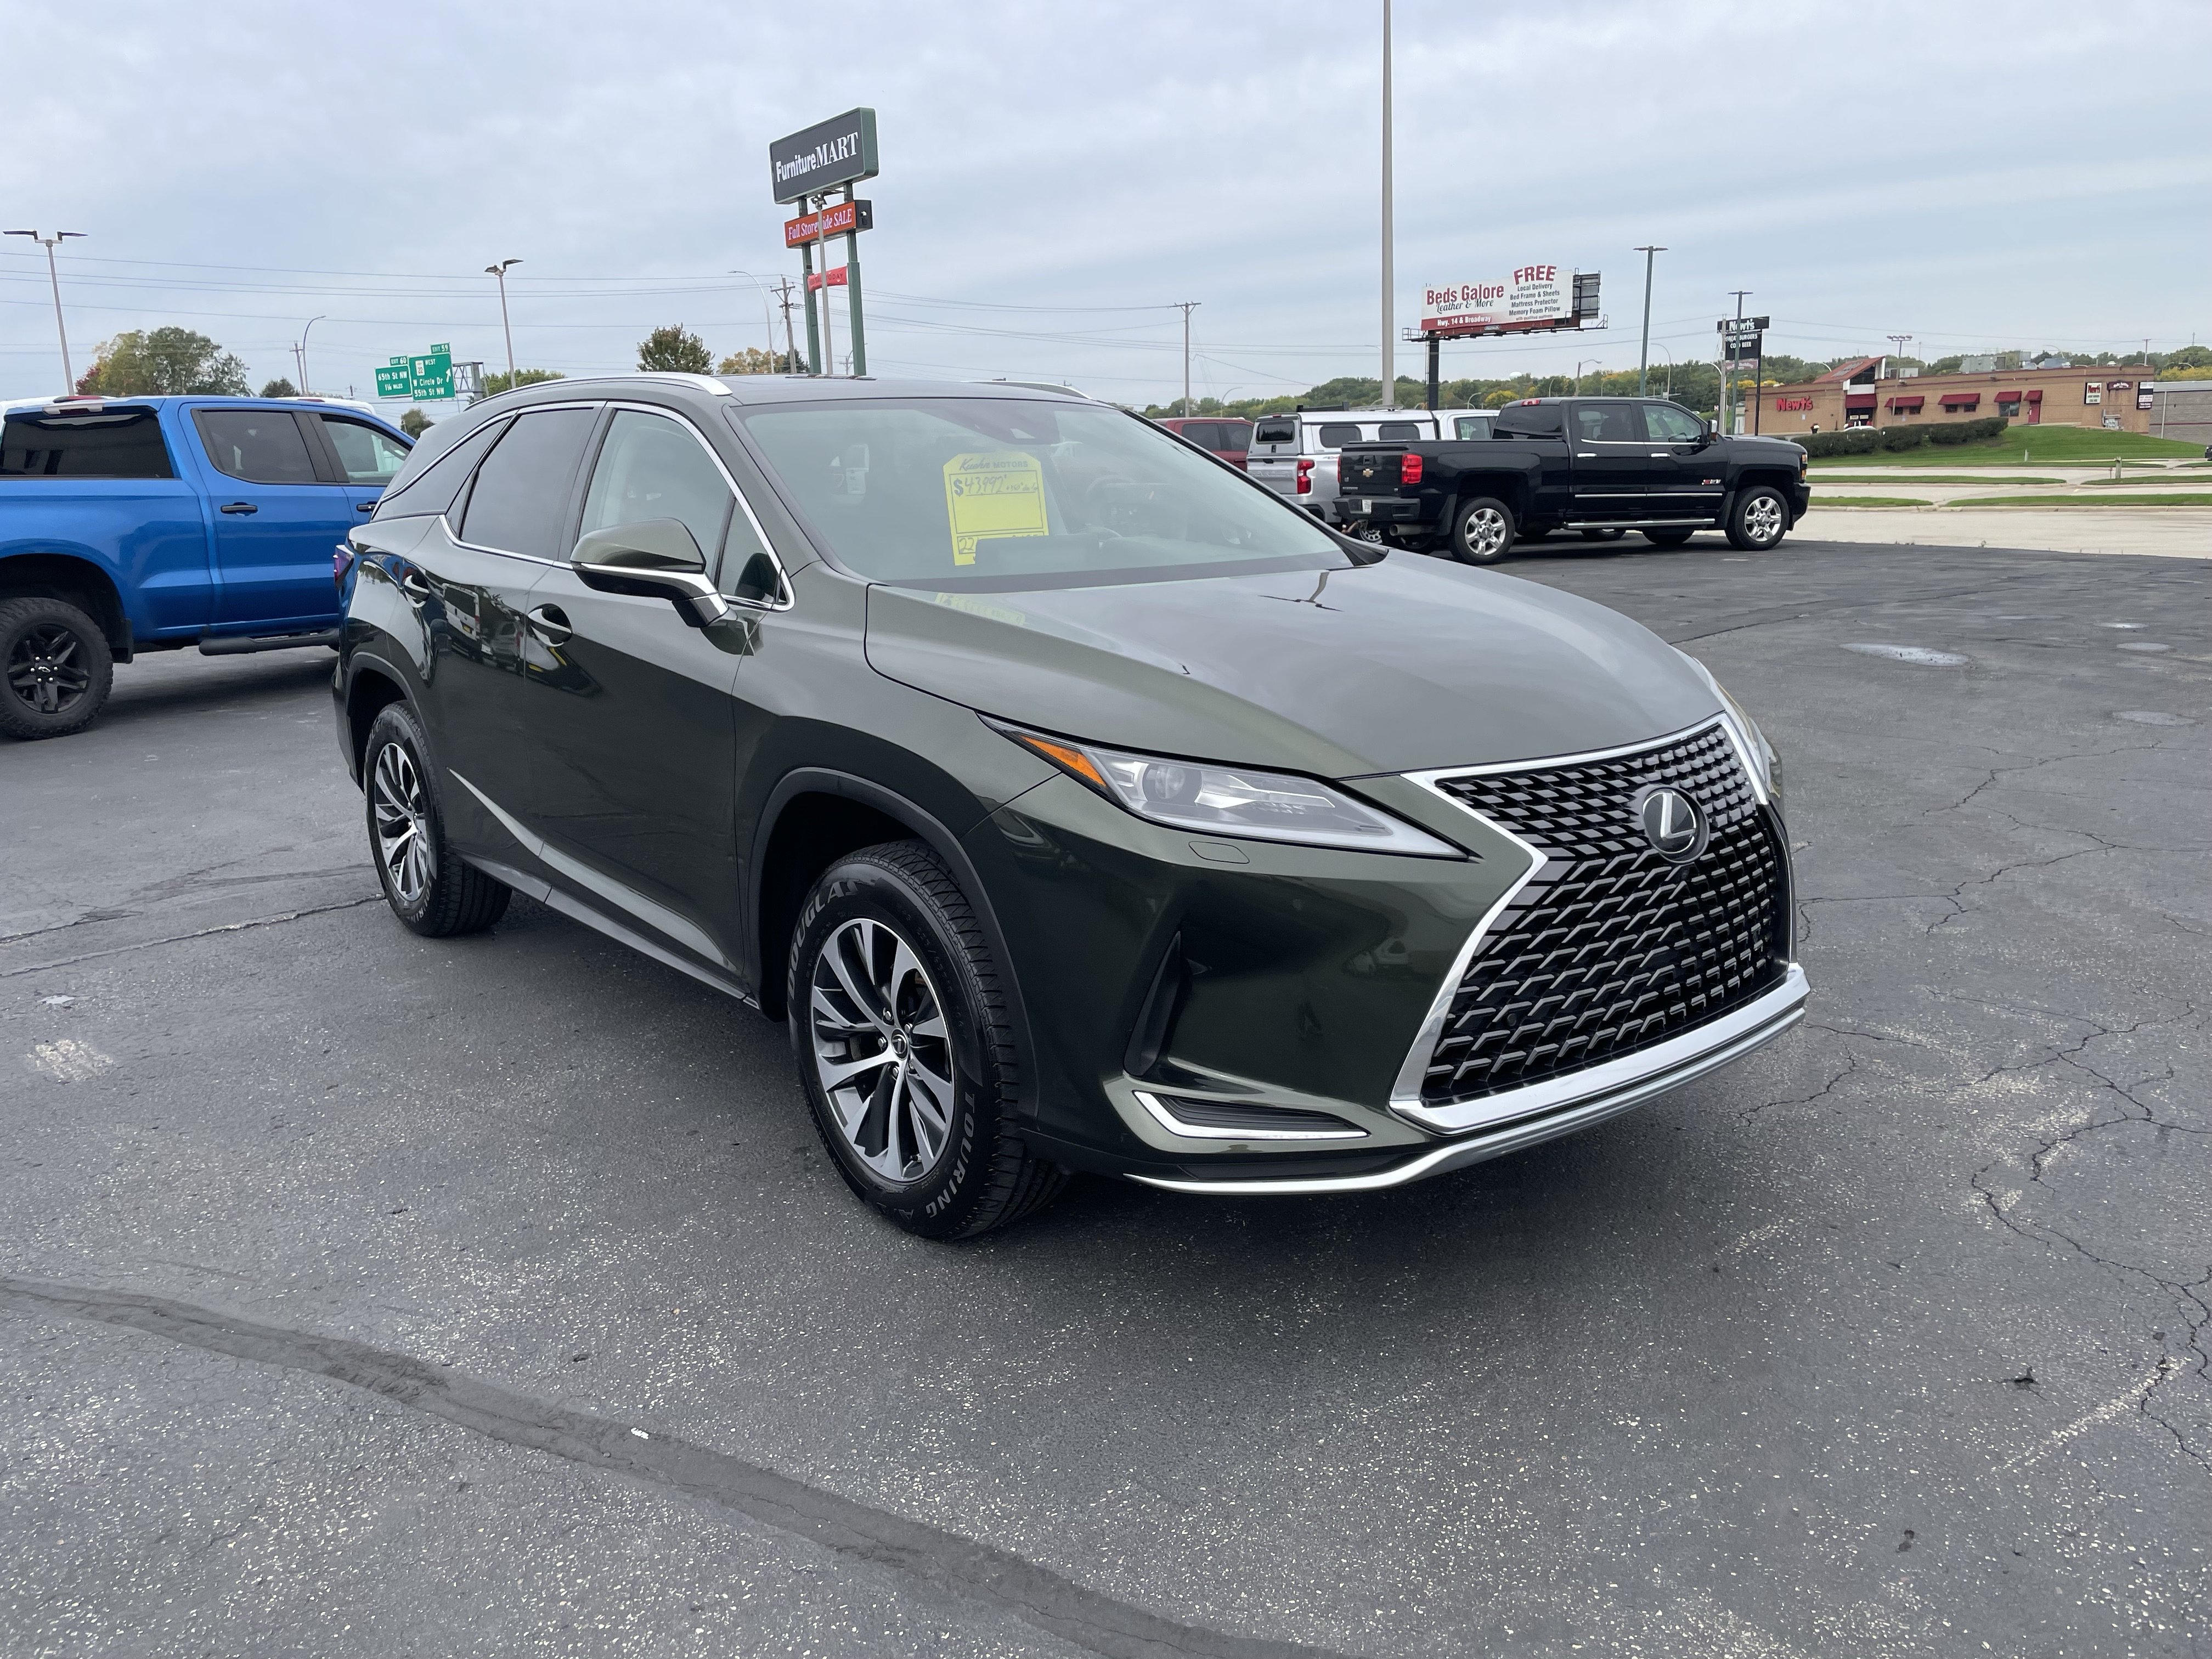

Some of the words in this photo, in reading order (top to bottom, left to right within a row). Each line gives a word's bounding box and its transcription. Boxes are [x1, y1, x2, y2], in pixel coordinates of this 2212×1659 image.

[776, 132, 859, 182] FurnitureMART
[788, 224, 799, 240] Fall
[801, 215, 833, 236] Storeide
[834, 208, 852, 227] SALE
[1514, 265, 1557, 285] FREE
[1427, 287, 1457, 305] Beds
[1462, 284, 1504, 301] Galore
[1436, 300, 1464, 314] Leather
[1465, 299, 1471, 308] &
[1474, 298, 1493, 308] More
[1437, 319, 1450, 328] Hwy.
[419, 378, 435, 386] Circle
[1776, 395, 1813, 411] Newt's
[993, 460, 1029, 469] MOTORS
[926, 1091, 975, 1218] TOURING
